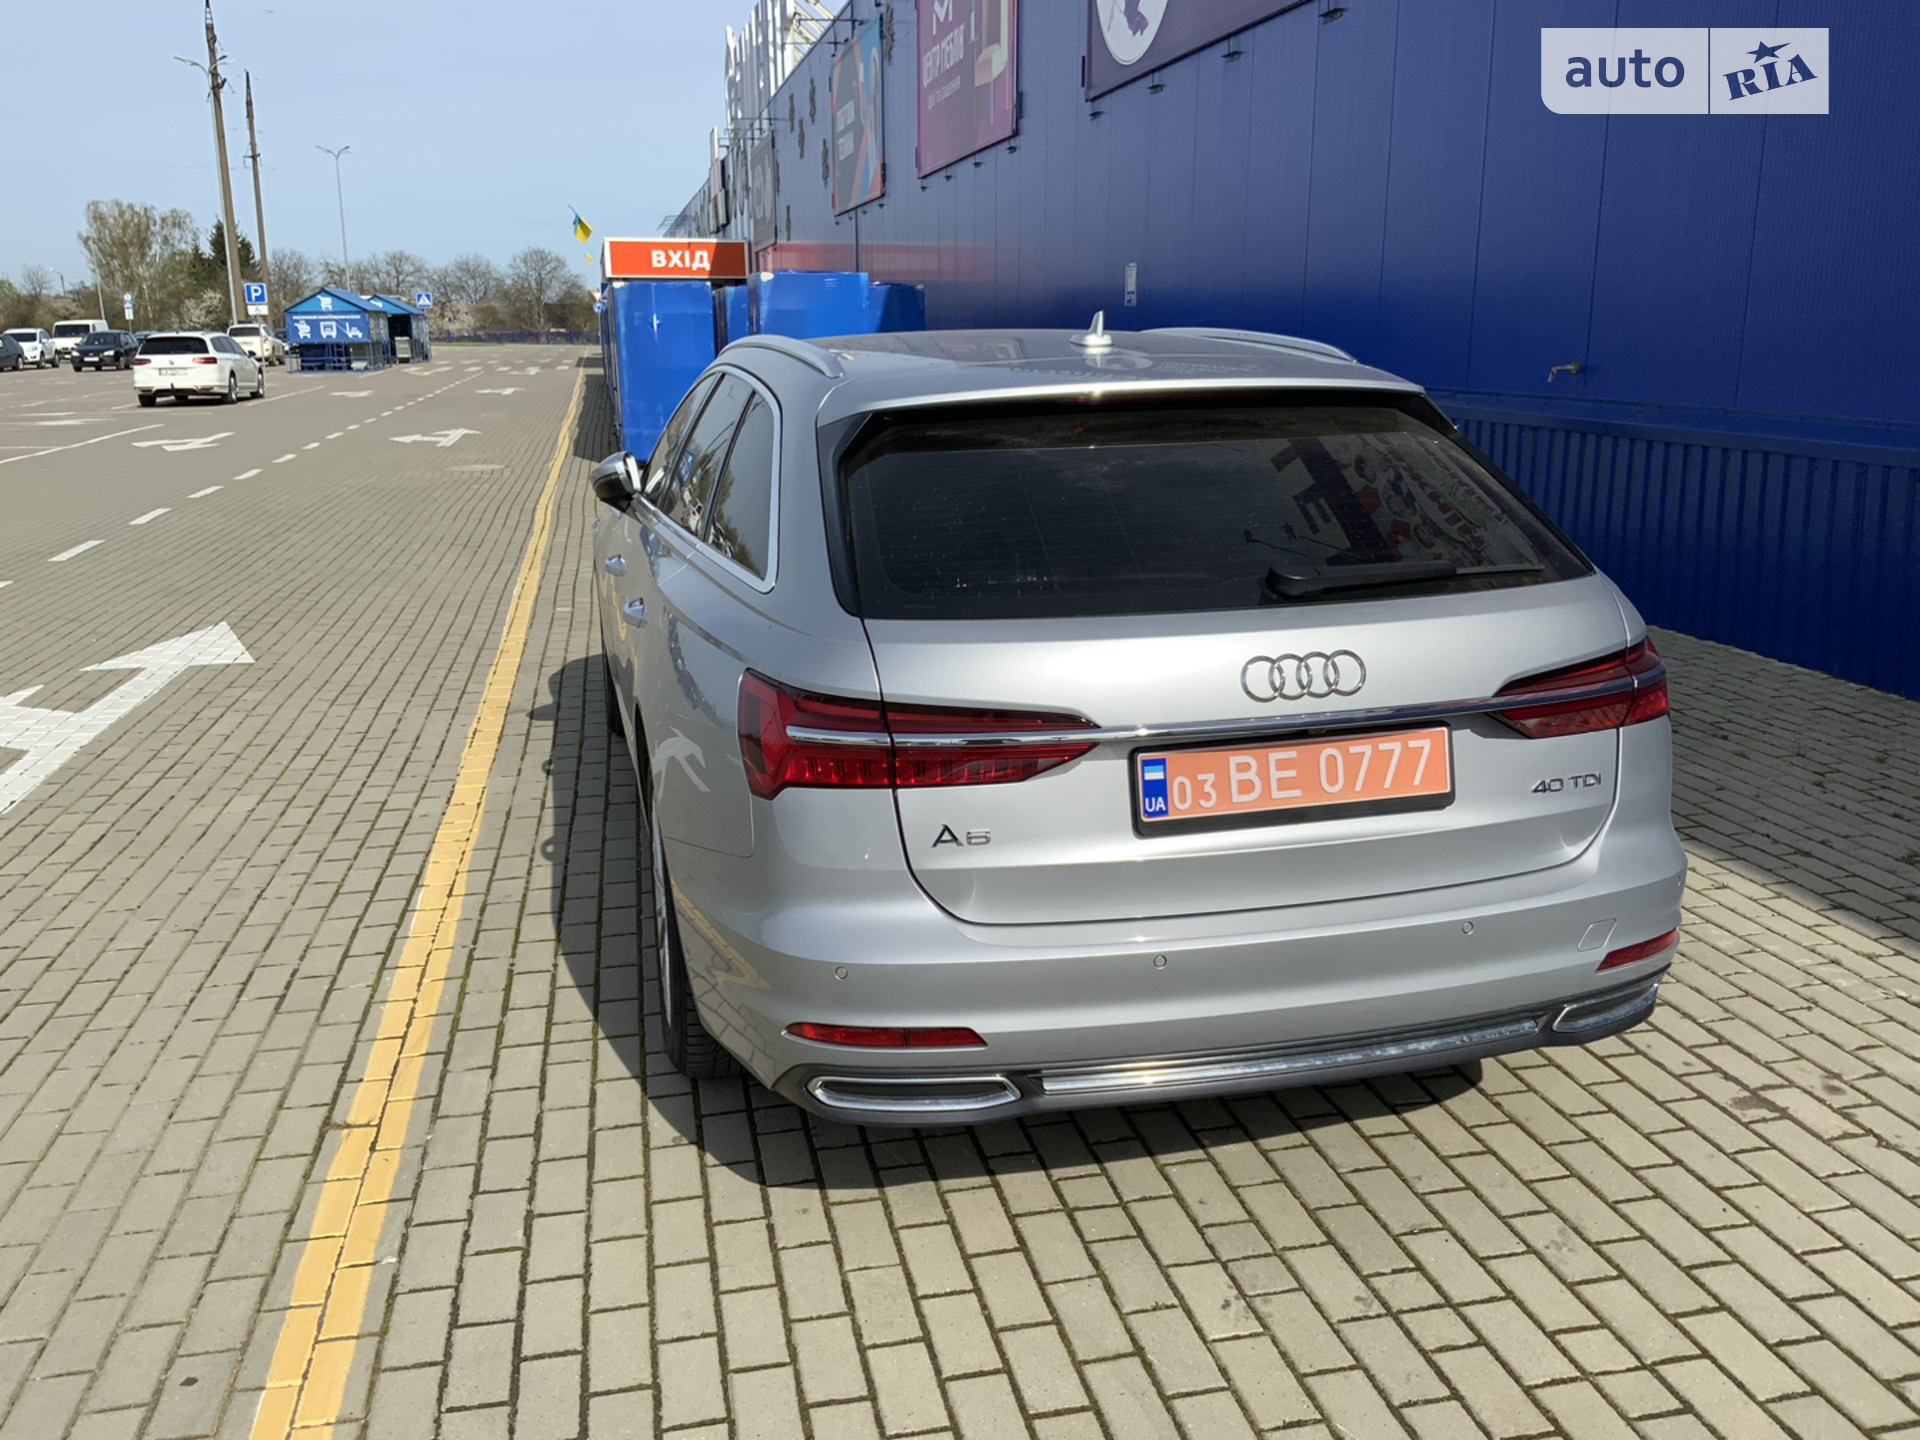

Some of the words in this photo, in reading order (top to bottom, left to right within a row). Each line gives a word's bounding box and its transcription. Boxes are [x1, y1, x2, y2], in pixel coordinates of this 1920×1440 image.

[651, 250, 711, 271] ВХІД
[250, 285, 262, 302] P
[1172, 773, 1218, 811] 03
[1229, 751, 1302, 804] BE
[1318, 738, 1432, 795] 0777
[1530, 778, 1564, 794] 40
[1568, 772, 1602, 789] TDI
[1145, 796, 1166, 812] UA
[930, 823, 992, 849] A6
